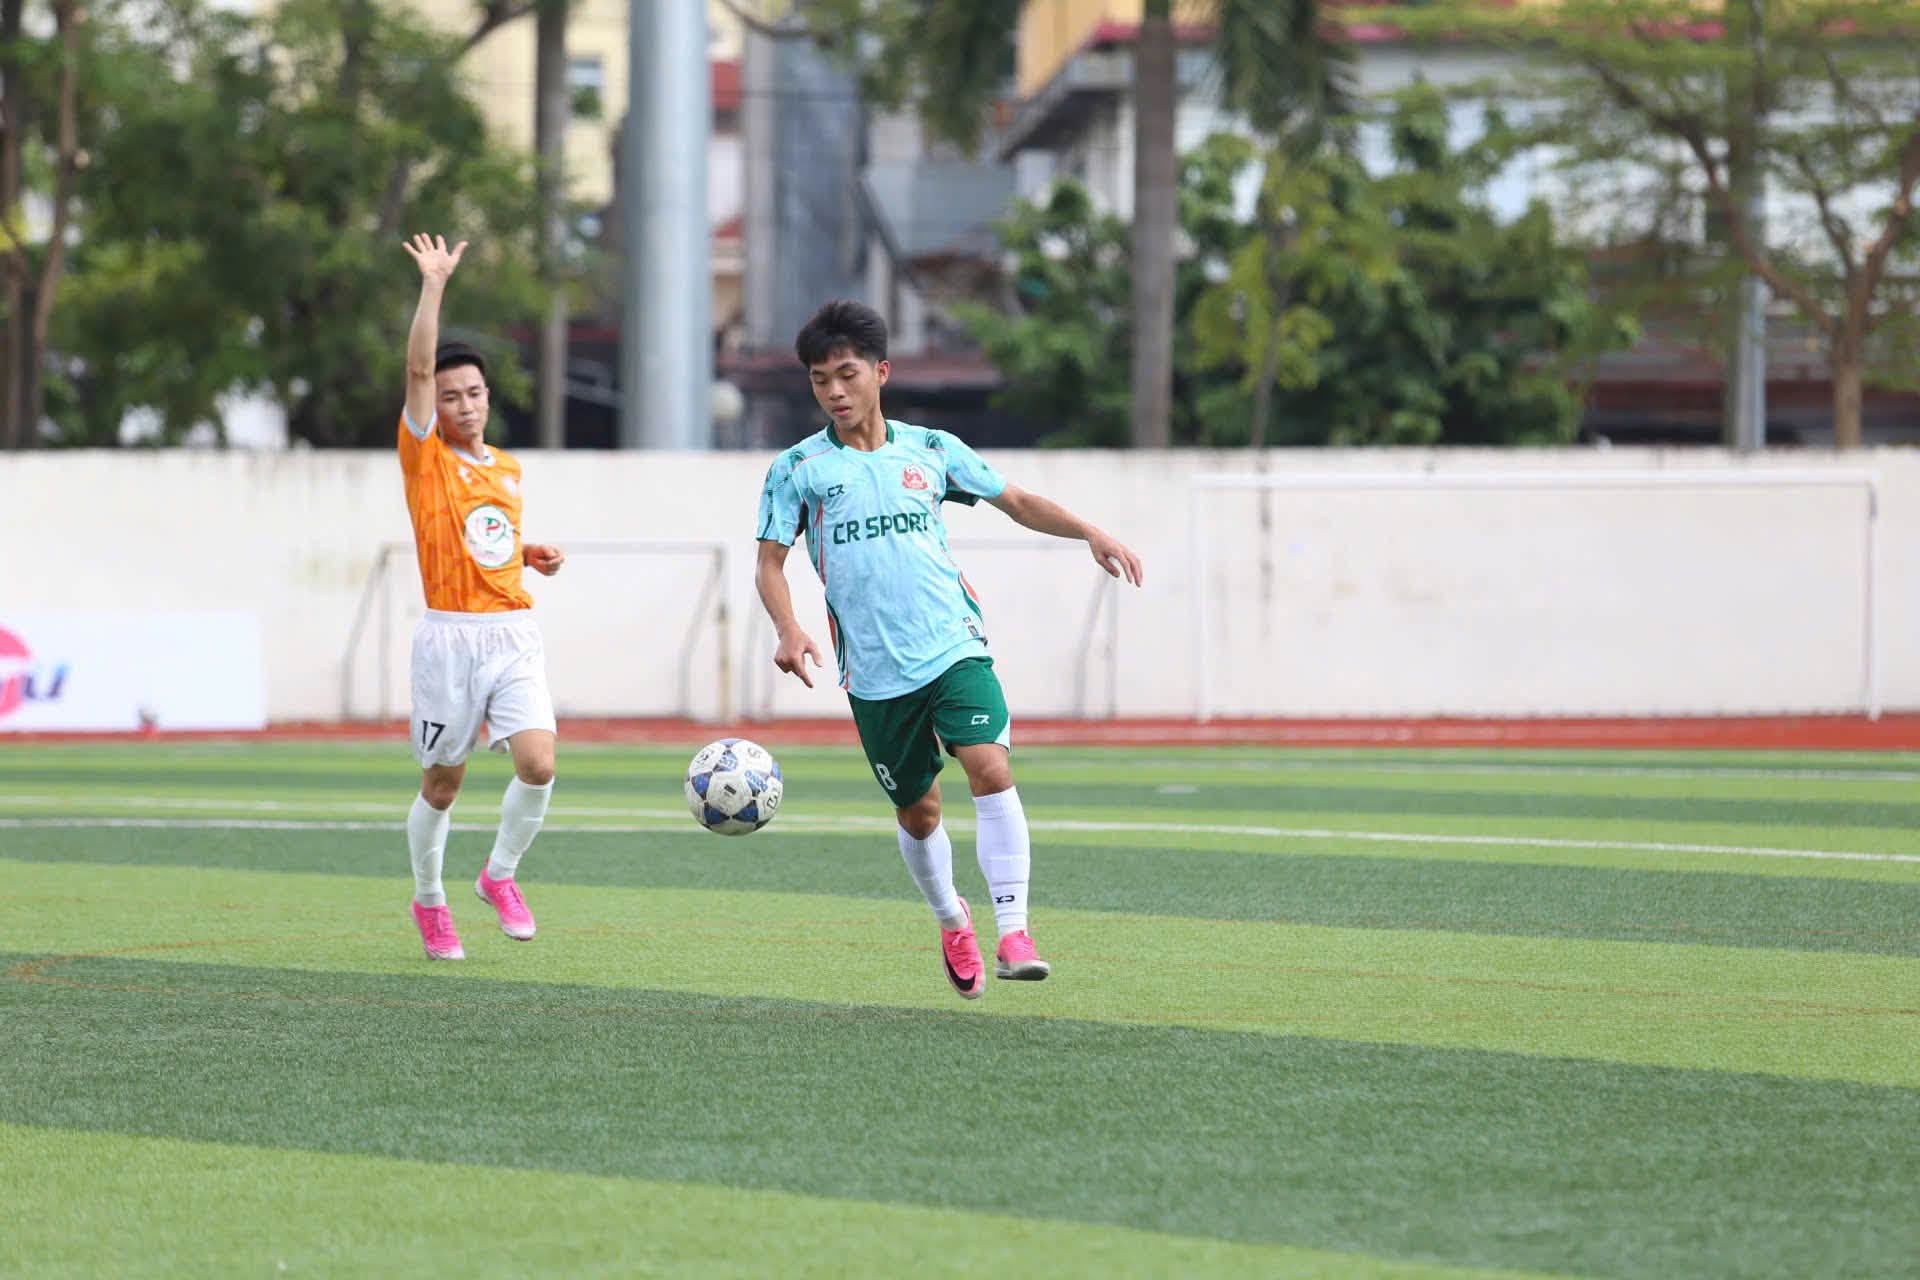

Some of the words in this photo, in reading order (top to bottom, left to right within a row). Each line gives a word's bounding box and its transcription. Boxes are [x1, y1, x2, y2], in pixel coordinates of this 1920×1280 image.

[833, 520, 861, 545] CR
[865, 513, 928, 540] SPORT
[422, 719, 446, 752] 17
[876, 763, 897, 791] 8
